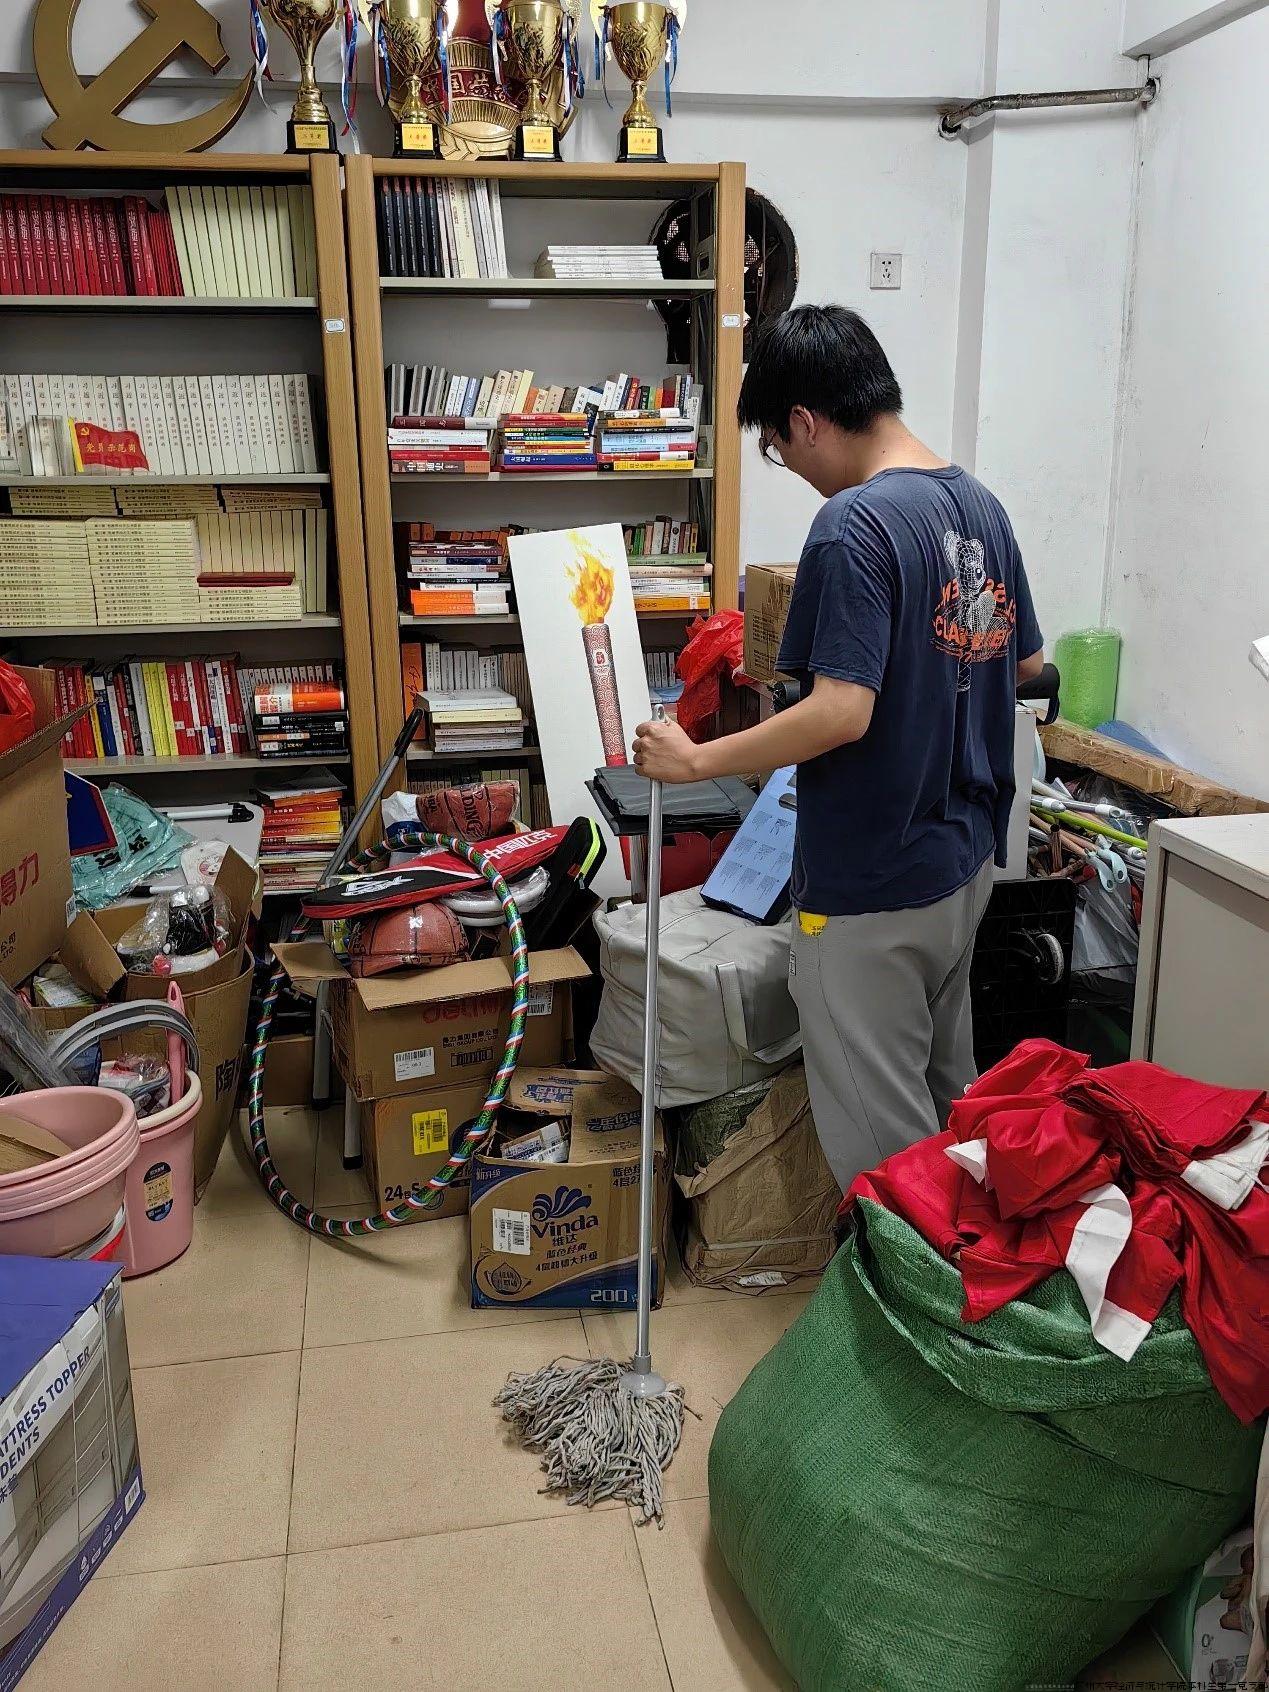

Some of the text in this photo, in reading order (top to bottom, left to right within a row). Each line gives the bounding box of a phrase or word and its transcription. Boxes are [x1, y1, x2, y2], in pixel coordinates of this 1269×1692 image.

[85, 442, 137, 453] 党员示范岗
[530, 1215, 599, 1238] Vinda
[552, 1233, 577, 1246] 维达
[590, 1289, 628, 1303] 200
[46, 1345, 91, 1404] TOPPER
